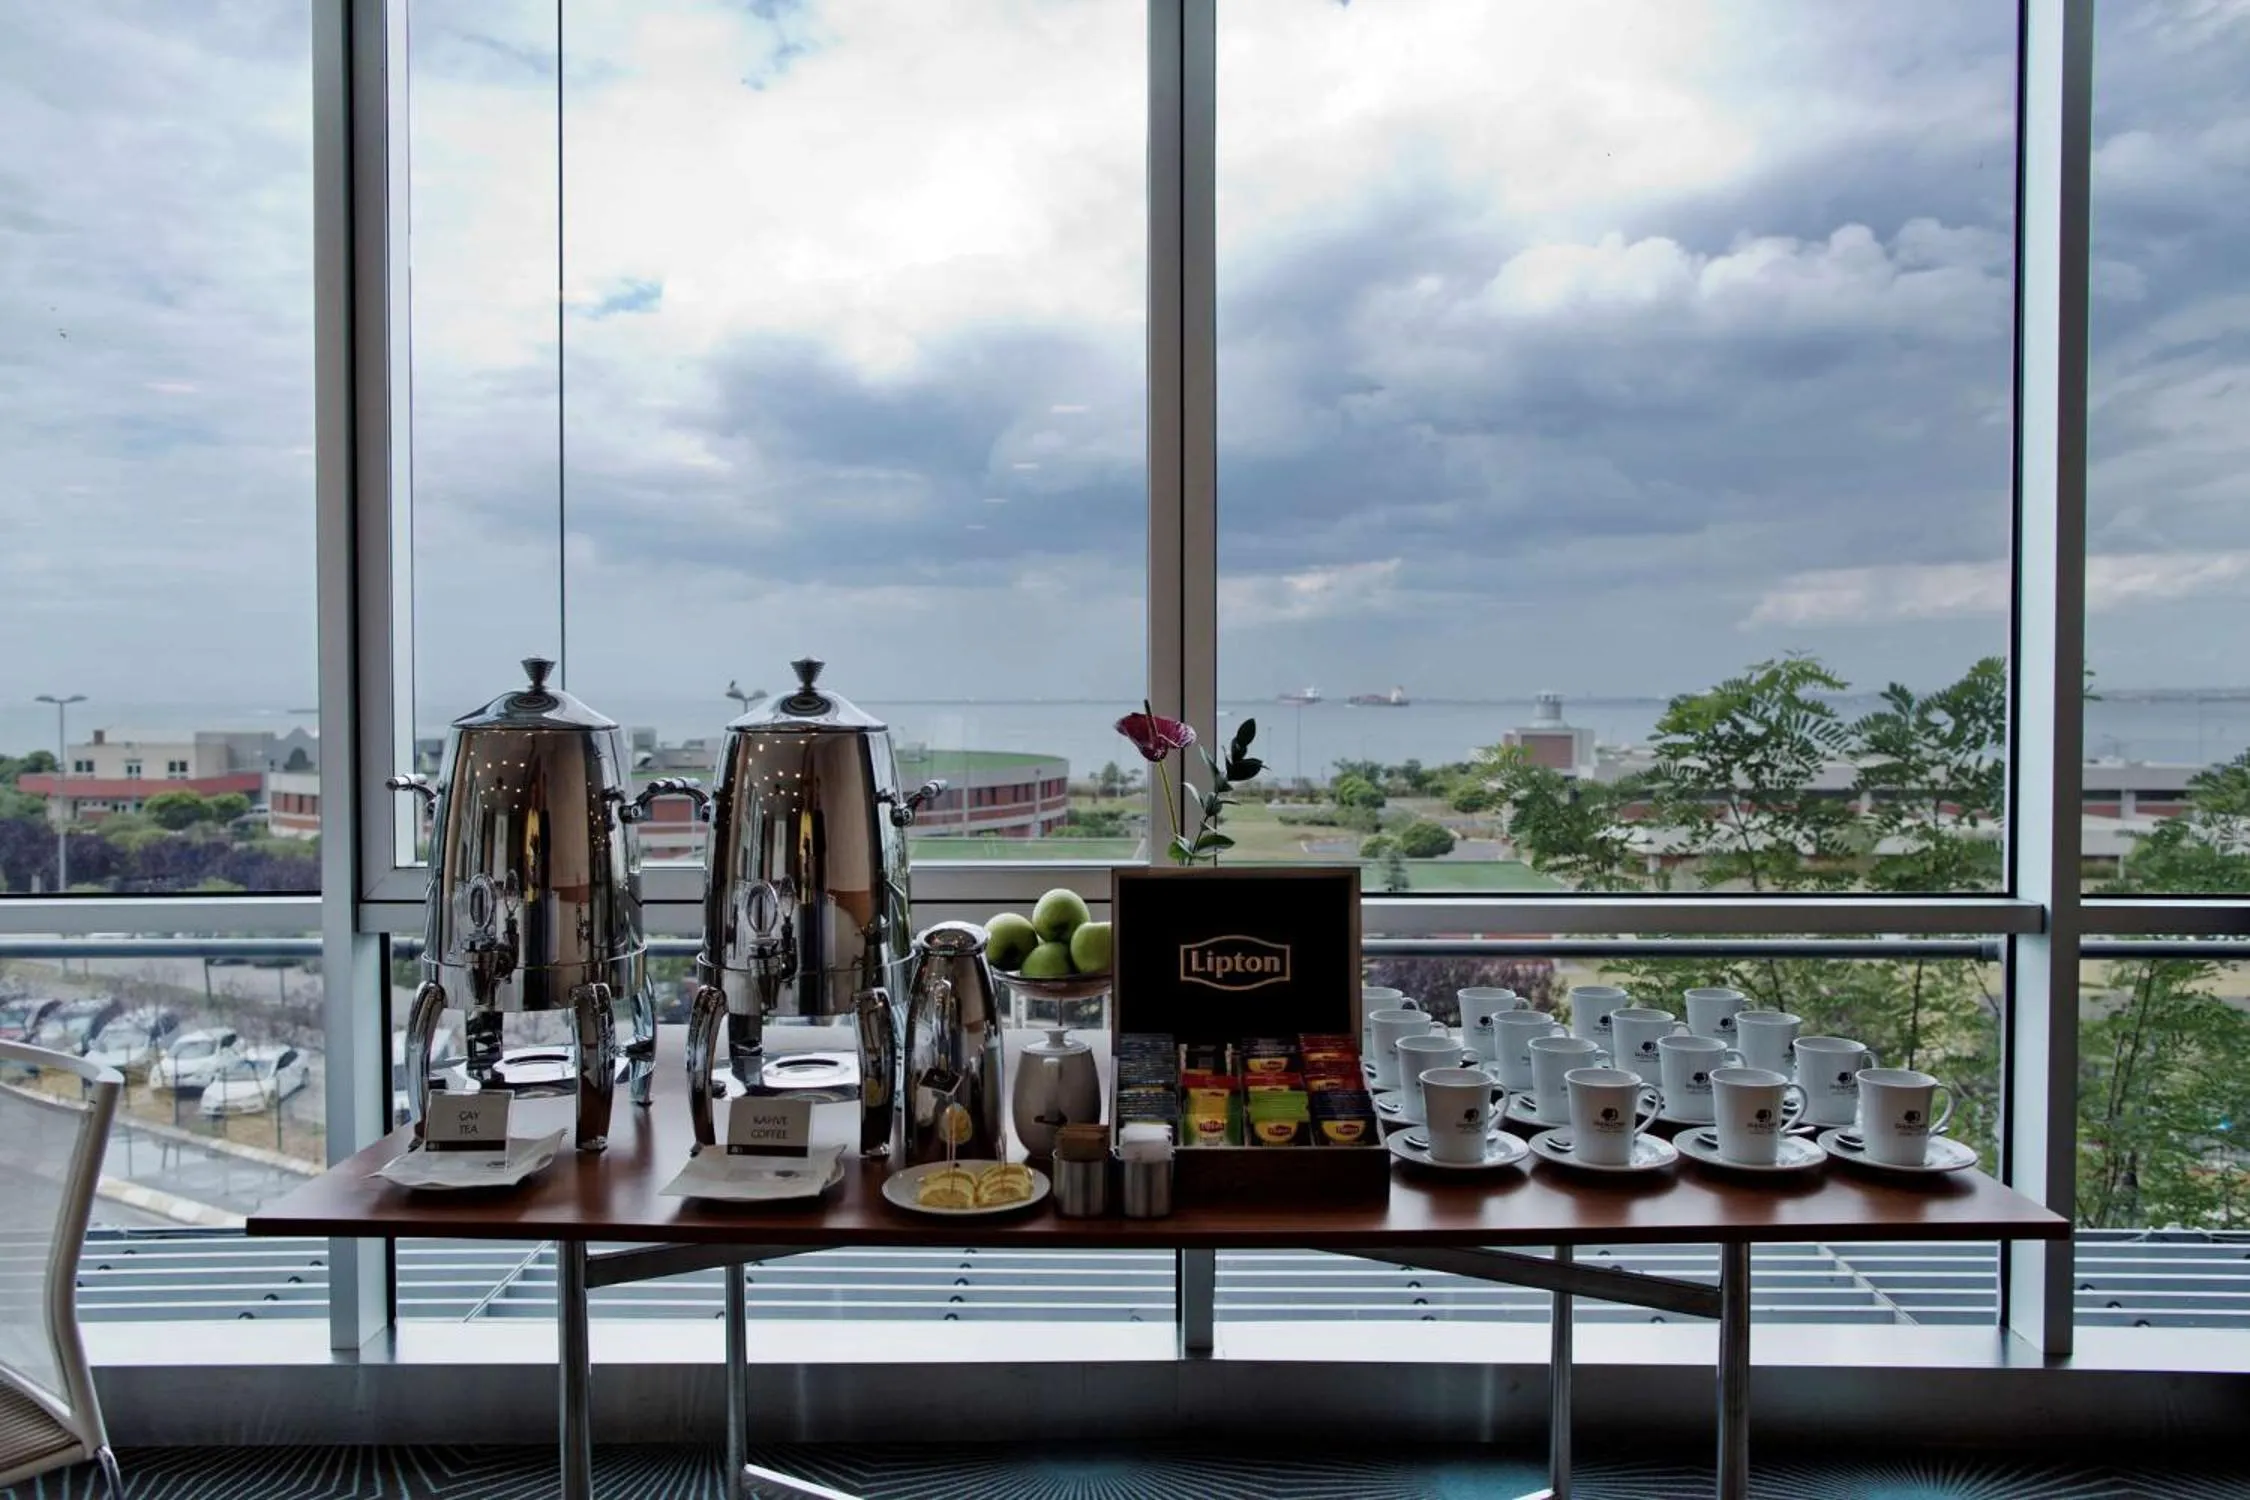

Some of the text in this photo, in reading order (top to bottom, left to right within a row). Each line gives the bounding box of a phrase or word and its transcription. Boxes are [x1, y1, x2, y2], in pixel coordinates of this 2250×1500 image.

[1191, 949, 1281, 979] Lipton
[459, 1124, 479, 1135] TEA
[751, 1129, 788, 1140] COFFEE
